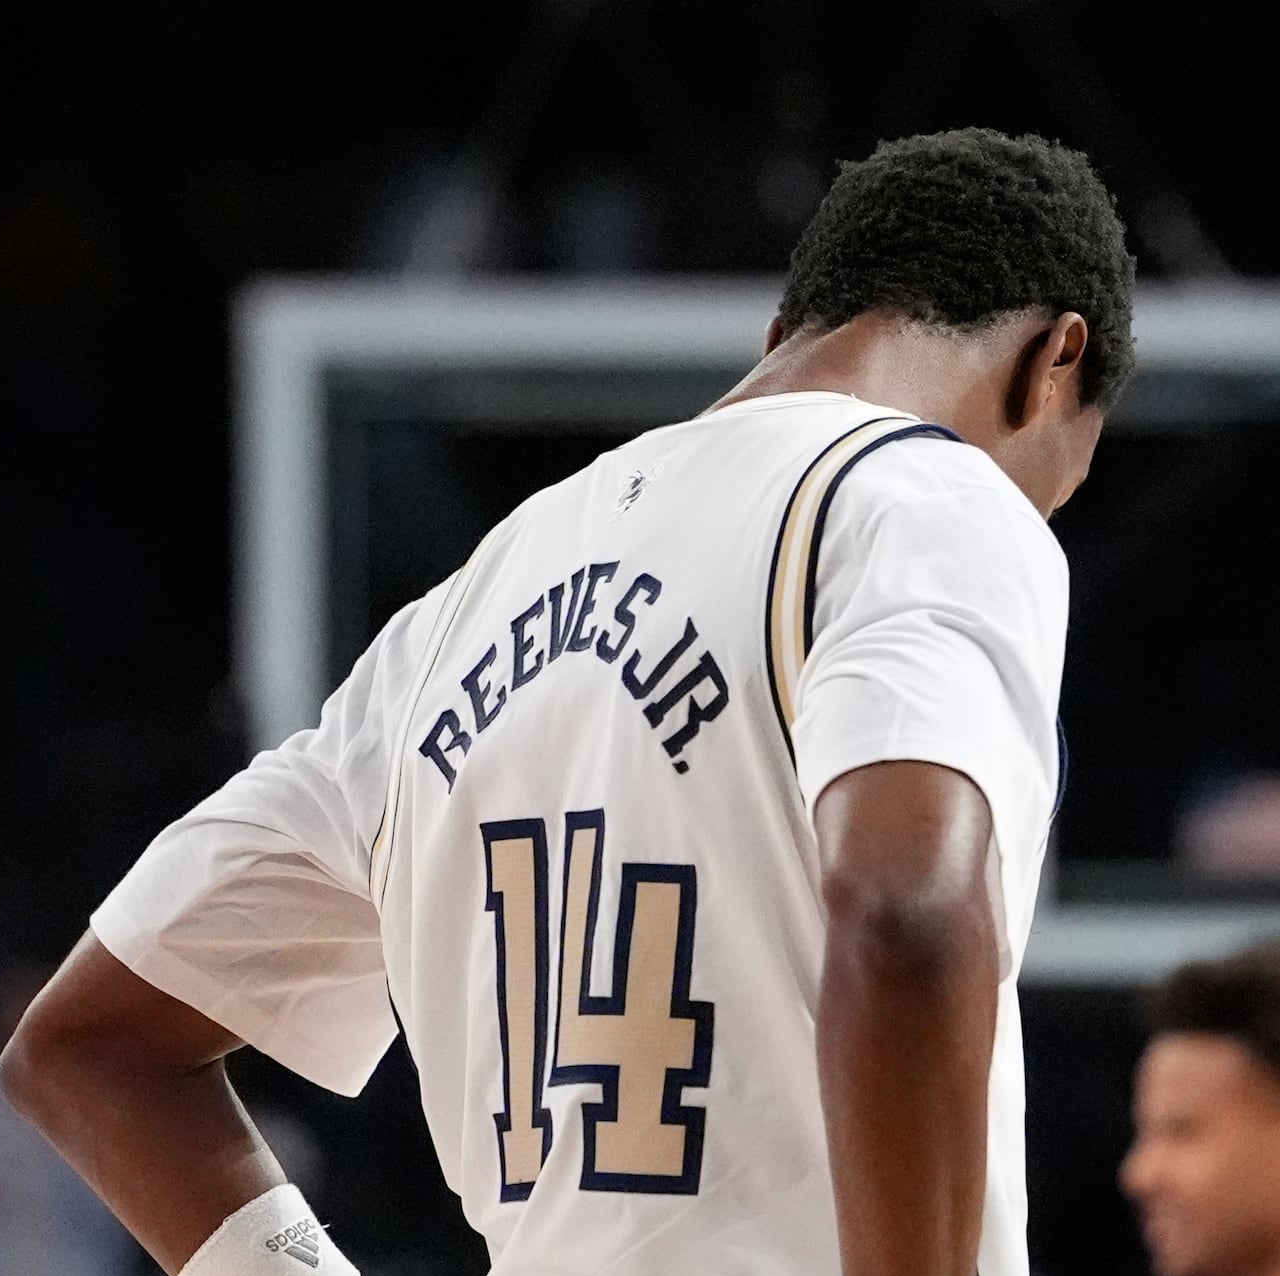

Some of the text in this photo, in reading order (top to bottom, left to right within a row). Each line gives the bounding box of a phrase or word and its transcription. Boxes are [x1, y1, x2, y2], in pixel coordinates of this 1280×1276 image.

[417, 560, 730, 796] REEVES JR.
[479, 807, 716, 1204] 14
[265, 1217, 317, 1253] adidas
